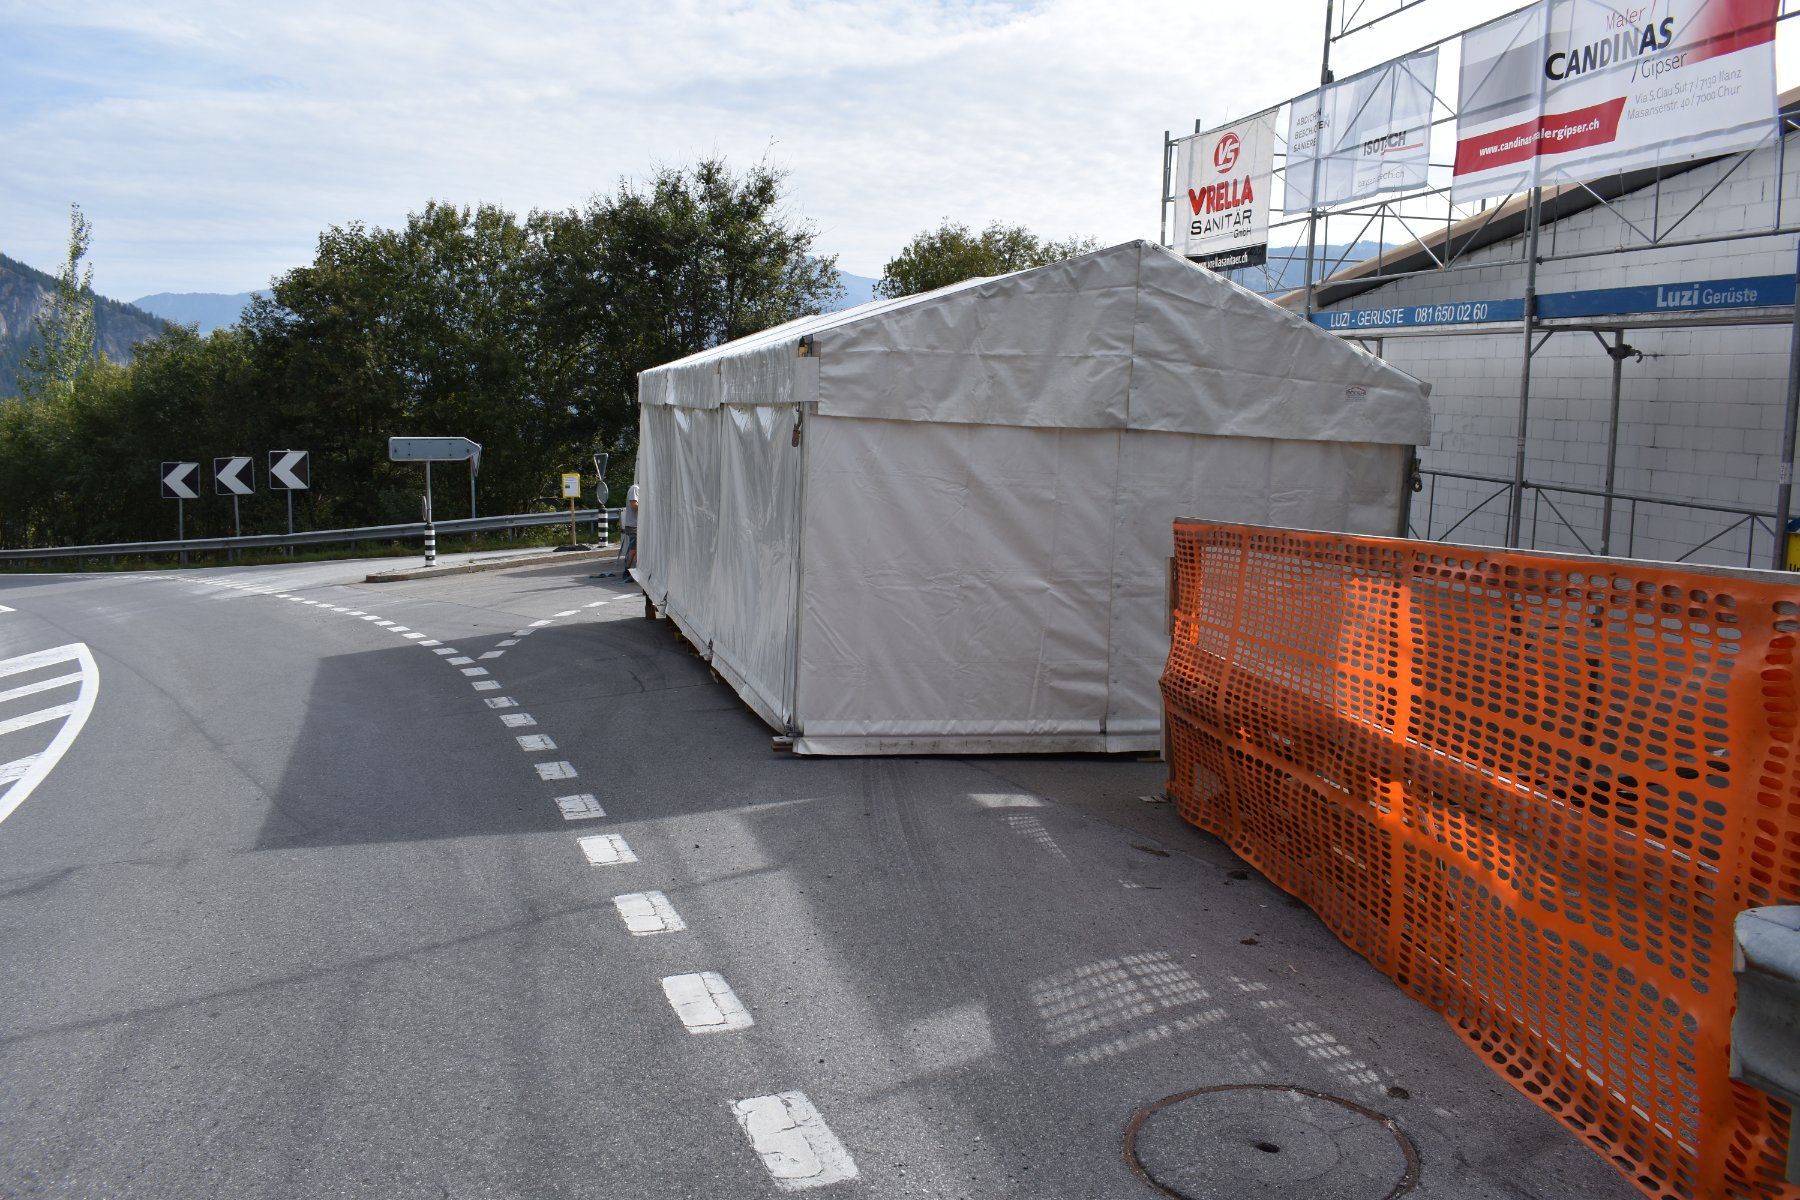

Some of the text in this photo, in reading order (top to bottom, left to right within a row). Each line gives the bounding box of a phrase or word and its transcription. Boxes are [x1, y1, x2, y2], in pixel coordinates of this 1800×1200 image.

[1606, 6, 1647, 32] Maler
[1545, 16, 1674, 81] CANDINAS
[1627, 100, 1679, 121] Masanserstr.
[1696, 91, 1716, 107] 7000
[1717, 84, 1742, 98] Chur
[1635, 94, 1648, 105] Via
[1363, 130, 1407, 156] ISOTCH
[1188, 174, 1254, 216] VRELLA
[1190, 207, 1252, 236] SANITÄR
[1233, 226, 1252, 239] GmbH
[1656, 283, 1758, 308] Luzi Gerüste
[1330, 312, 1351, 328] LUZI
[1414, 305, 1433, 323] 081
[1434, 305, 1455, 322] 650
[1456, 304, 1471, 321] 02
[1473, 303, 1488, 320] 60
